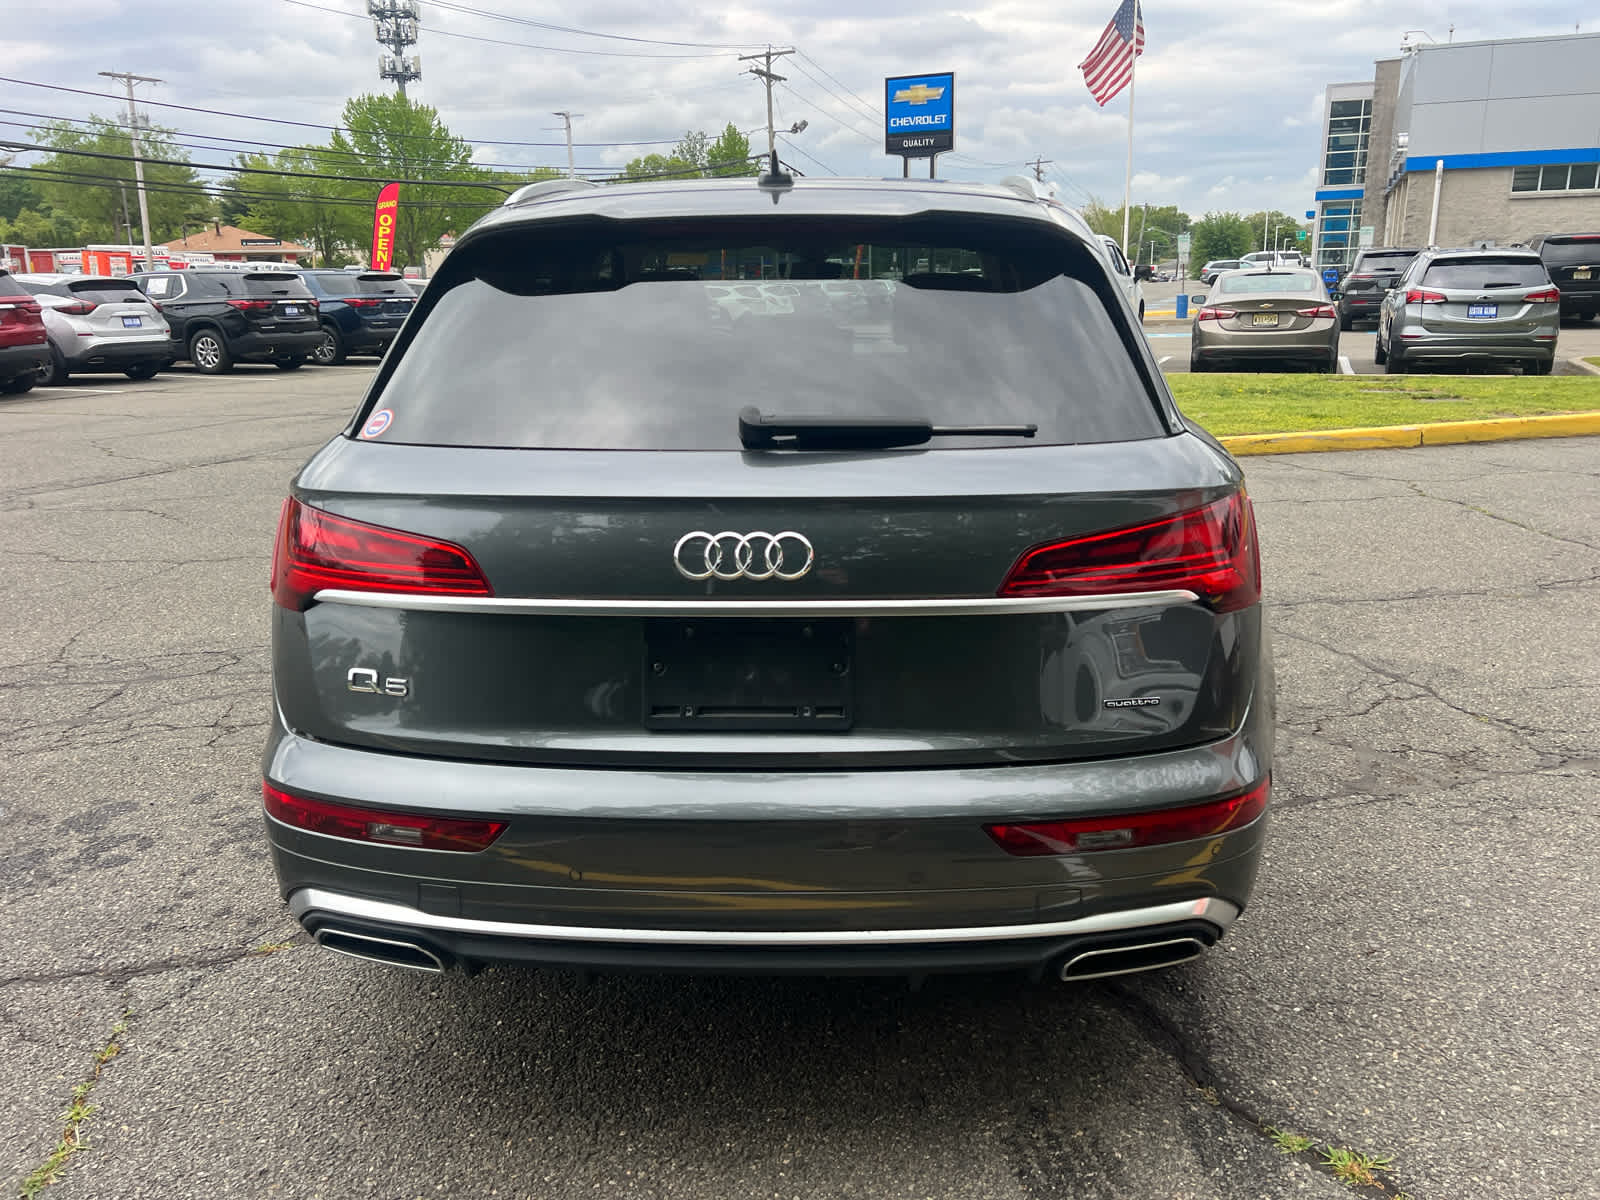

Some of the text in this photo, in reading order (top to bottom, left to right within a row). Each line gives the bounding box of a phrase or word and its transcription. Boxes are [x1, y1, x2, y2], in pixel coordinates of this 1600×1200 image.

[890, 114, 947, 127] CHEVROLET
[903, 138, 935, 147] QUALITY
[377, 200, 397, 209] GRAND
[347, 667, 408, 697] Q5
[1106, 699, 1159, 708] quattro
